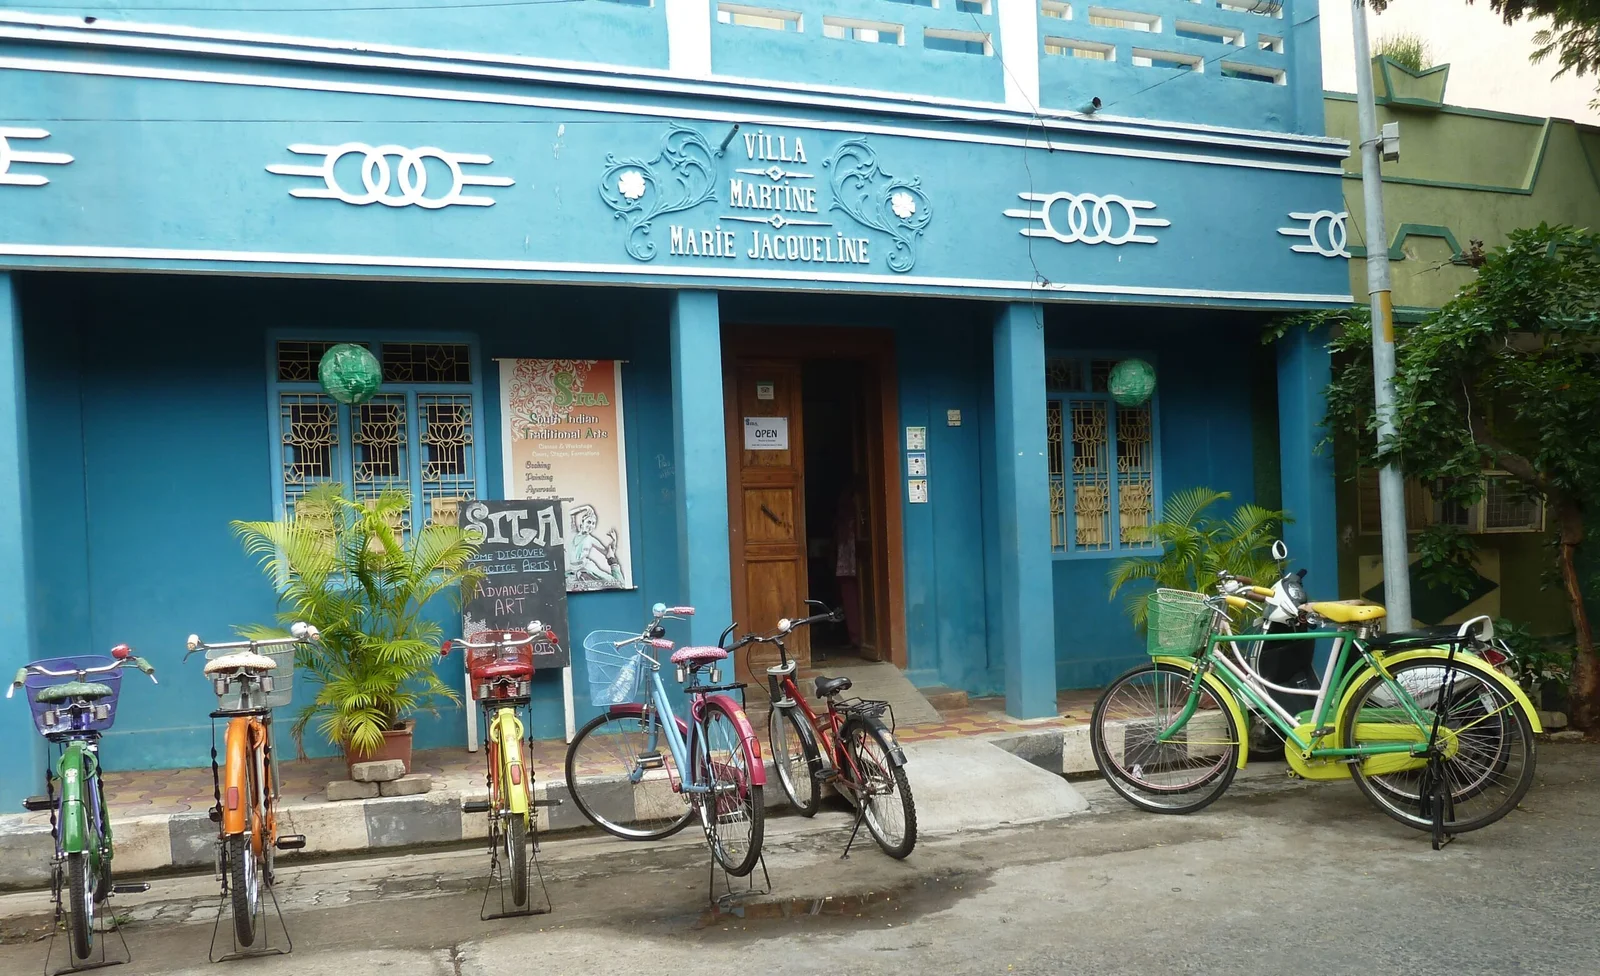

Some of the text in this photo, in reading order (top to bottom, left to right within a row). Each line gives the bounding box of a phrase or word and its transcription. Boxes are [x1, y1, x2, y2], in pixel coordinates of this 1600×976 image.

[529, 412, 599, 425] South Indian
[522, 427, 608, 440] Traditional Arts
[755, 429, 777, 438] OPEN
[496, 549, 545, 559] DISCOVER
[474, 580, 539, 599] ADVANCED
[495, 598, 525, 616] ART
